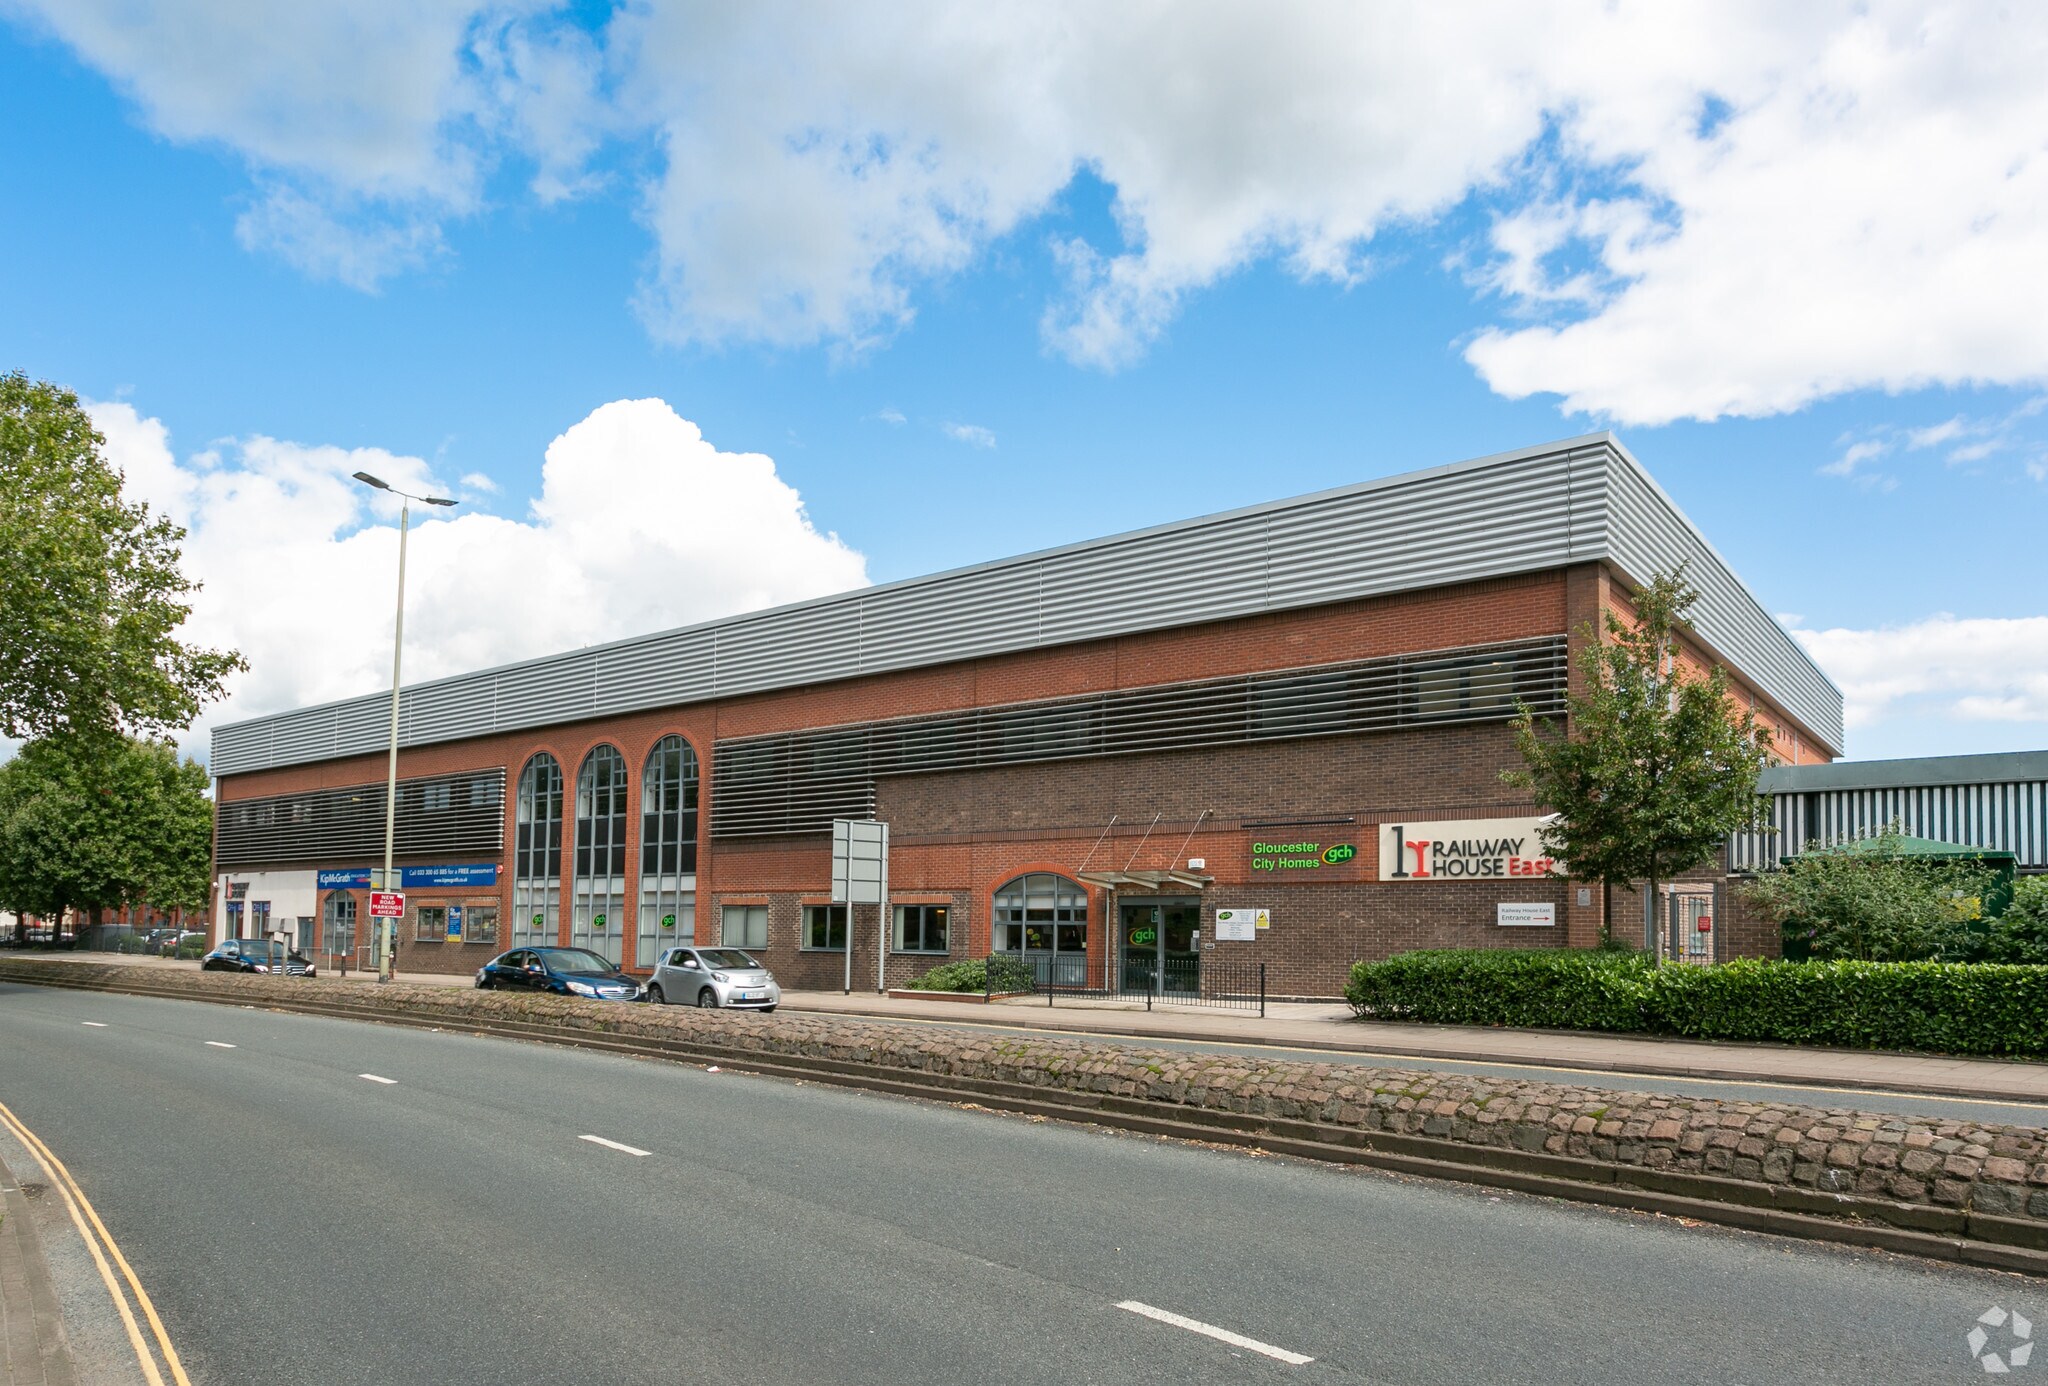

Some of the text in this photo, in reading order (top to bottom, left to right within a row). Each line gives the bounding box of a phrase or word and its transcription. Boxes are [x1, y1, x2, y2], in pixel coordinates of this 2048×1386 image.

[1252, 842, 1320, 854] Gloucester
[1328, 844, 1353, 862] gch
[1432, 838, 1525, 857] RAILWAY
[1252, 857, 1320, 871] City Homes
[1432, 857, 1554, 876] HOUSE East
[595, 914, 606, 926] gch
[663, 914, 675, 927] gch
[1135, 928, 1155, 943] gch
